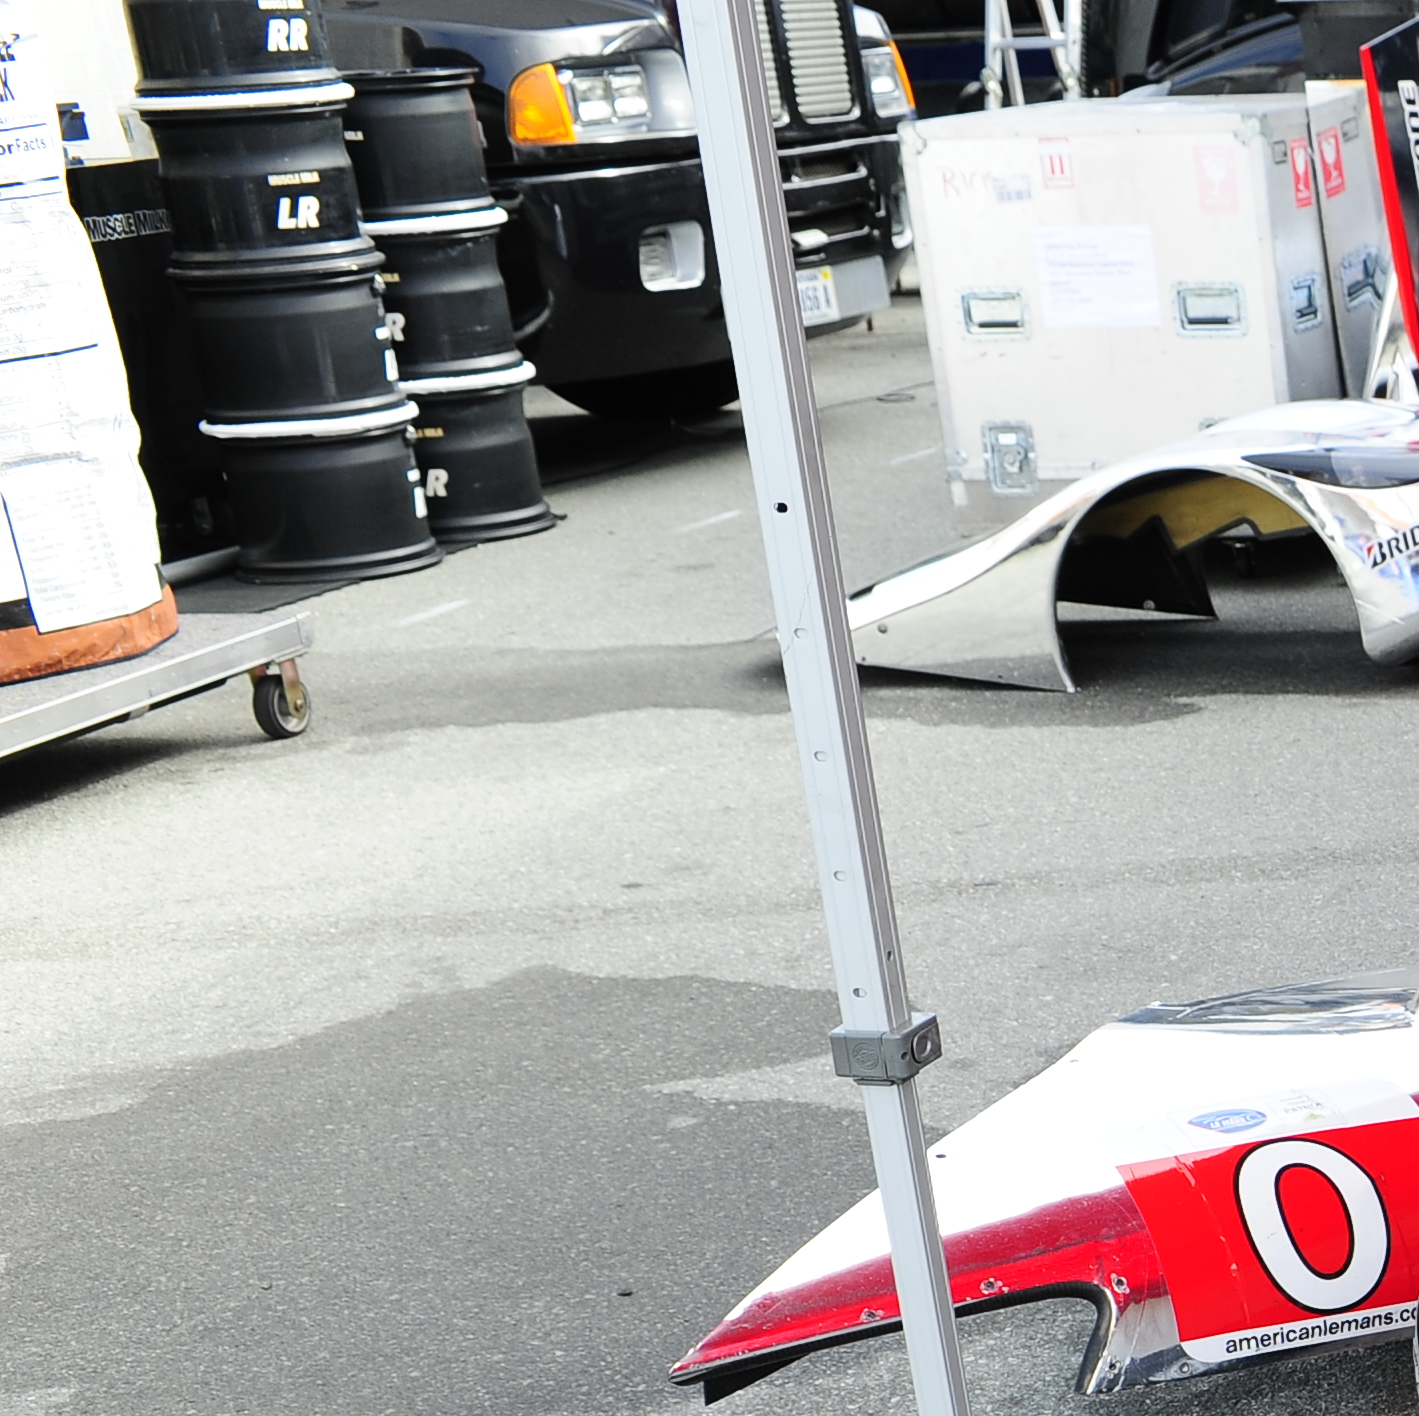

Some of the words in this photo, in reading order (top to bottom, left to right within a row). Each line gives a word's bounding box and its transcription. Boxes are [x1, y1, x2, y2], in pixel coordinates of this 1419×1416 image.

[267, 18, 309, 51] RR
[84, 212, 137, 242] MUSCLE
[277, 196, 321, 229] LR
[1233, 1137, 1392, 1315] 0
[1225, 1305, 1417, 1354] americanlemans.co
